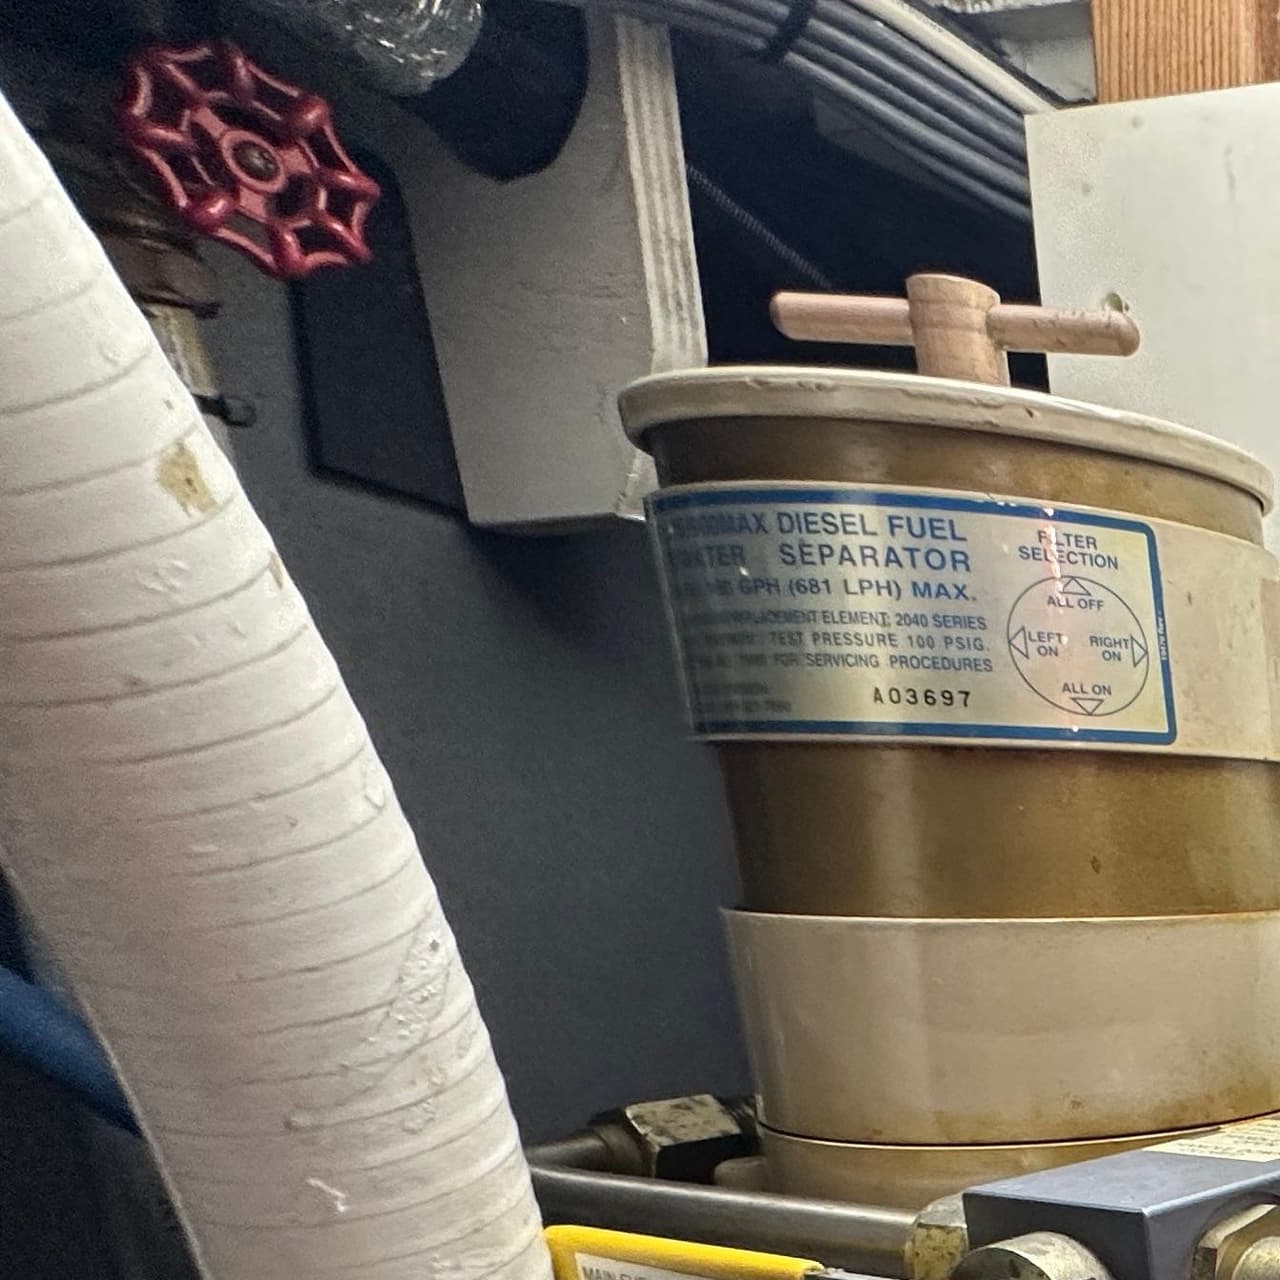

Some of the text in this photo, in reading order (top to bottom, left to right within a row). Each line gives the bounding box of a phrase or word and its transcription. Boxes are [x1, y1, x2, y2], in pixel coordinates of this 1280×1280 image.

[777, 511, 878, 536] DIESEL
[888, 516, 968, 542] FUEL
[779, 543, 971, 573] SEPARATOR
[739, 577, 781, 597] GPH
[788, 578, 832, 598] (681
[844, 579, 901, 601] LPH)
[912, 580, 977, 601] MAX.
[1047, 596, 1105, 611] ALL OFF
[895, 613, 929, 628] 2040
[932, 614, 989, 631] SERIES
[768, 630, 804, 647] TEST
[812, 631, 898, 648] PRESSURE
[908, 634, 936, 650] 100
[1028, 631, 1063, 644] LEFT
[1089, 634, 1131, 650] RIGHT
[1037, 645, 1059, 657] ON
[1102, 650, 1122, 662] ON
[805, 652, 880, 669] SERVICING
[889, 655, 994, 673] PROCEDURES
[873, 686, 971, 708] A03697
[1062, 681, 1113, 697] ALL ON
